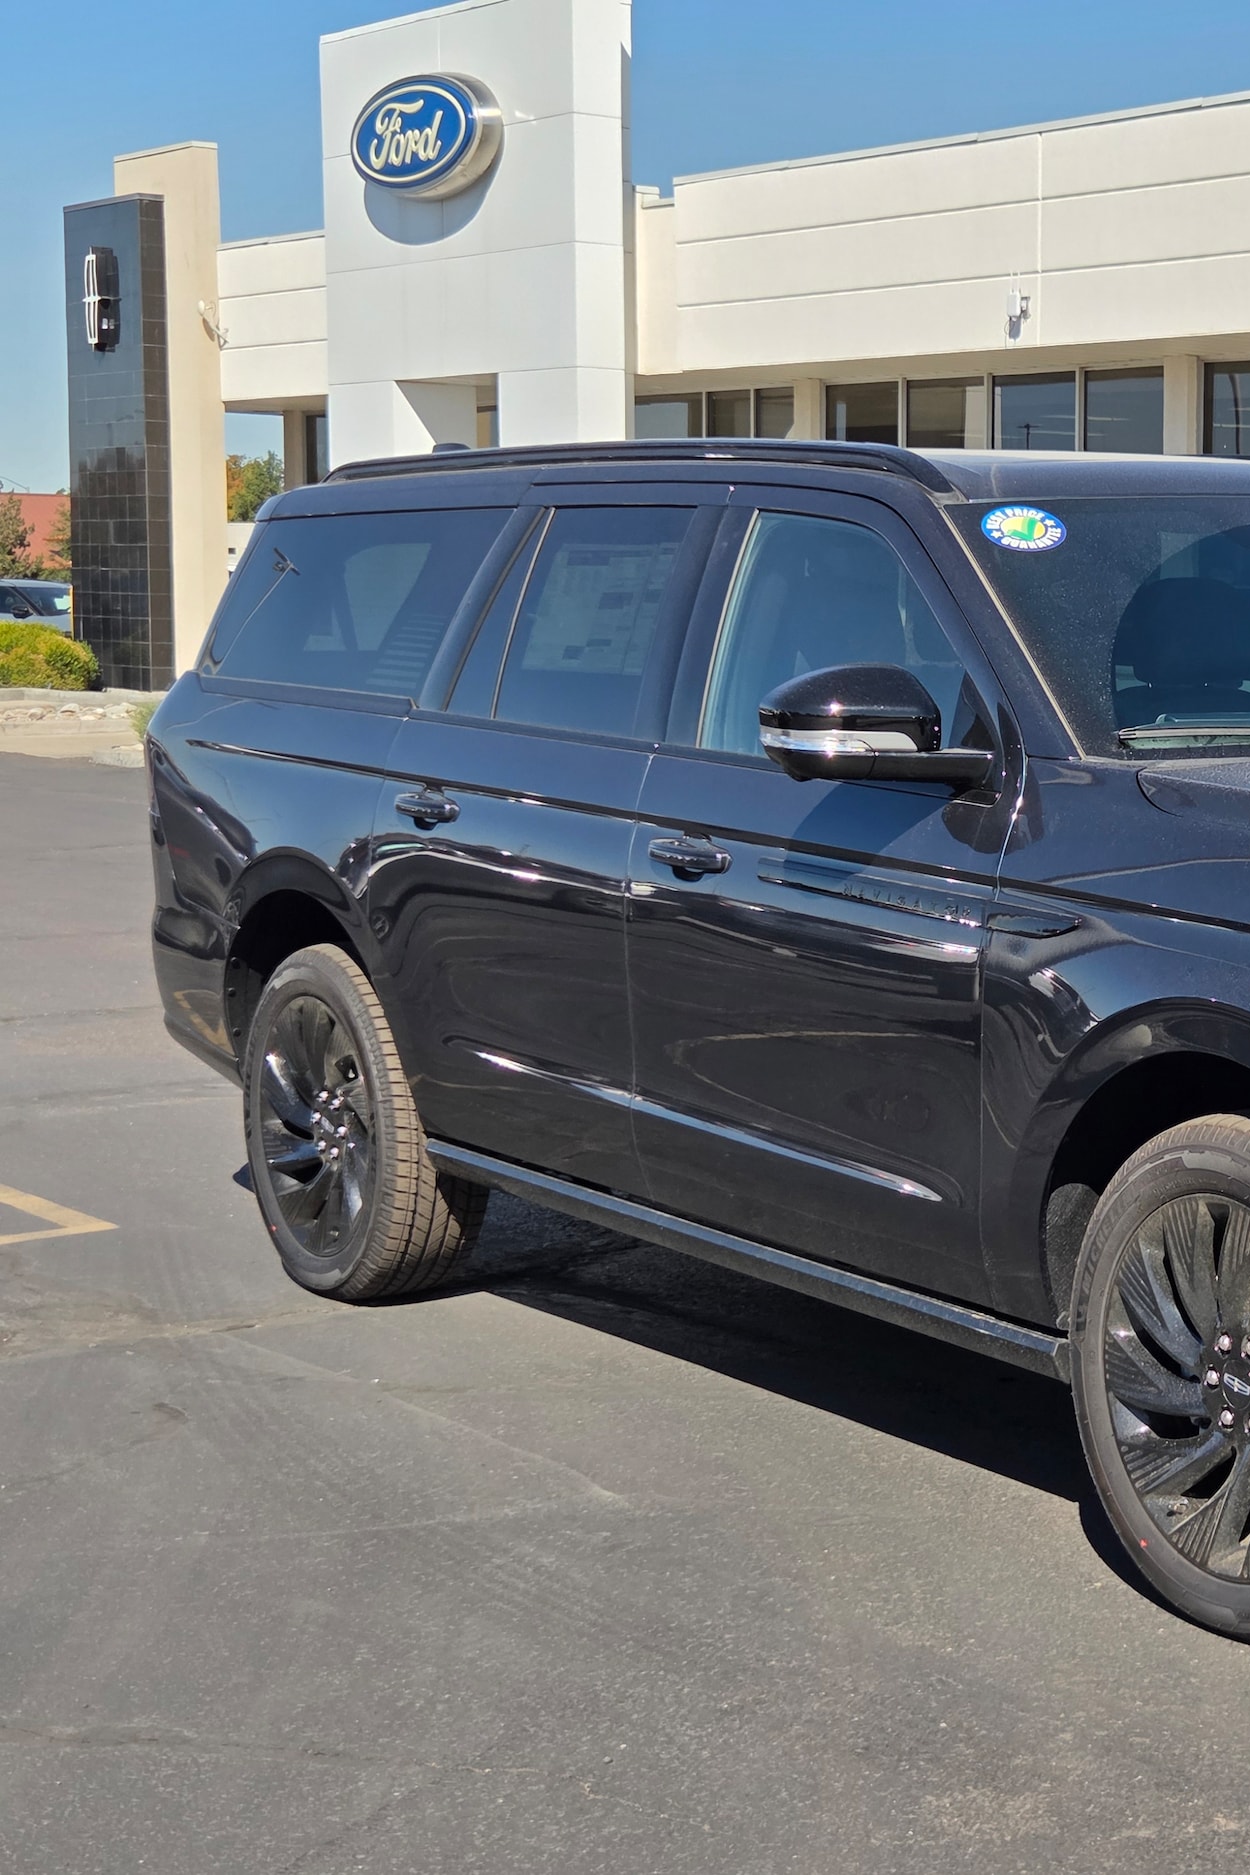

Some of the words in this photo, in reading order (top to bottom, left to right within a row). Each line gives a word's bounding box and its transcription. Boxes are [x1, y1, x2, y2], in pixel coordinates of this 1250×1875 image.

[370, 99, 443, 170] Ford
[986, 511, 1007, 529] BEST
[1004, 508, 1045, 521] PRICE
[1001, 527, 1061, 549] GUARANTEE
[842, 882, 972, 918] NAVIGATOR
